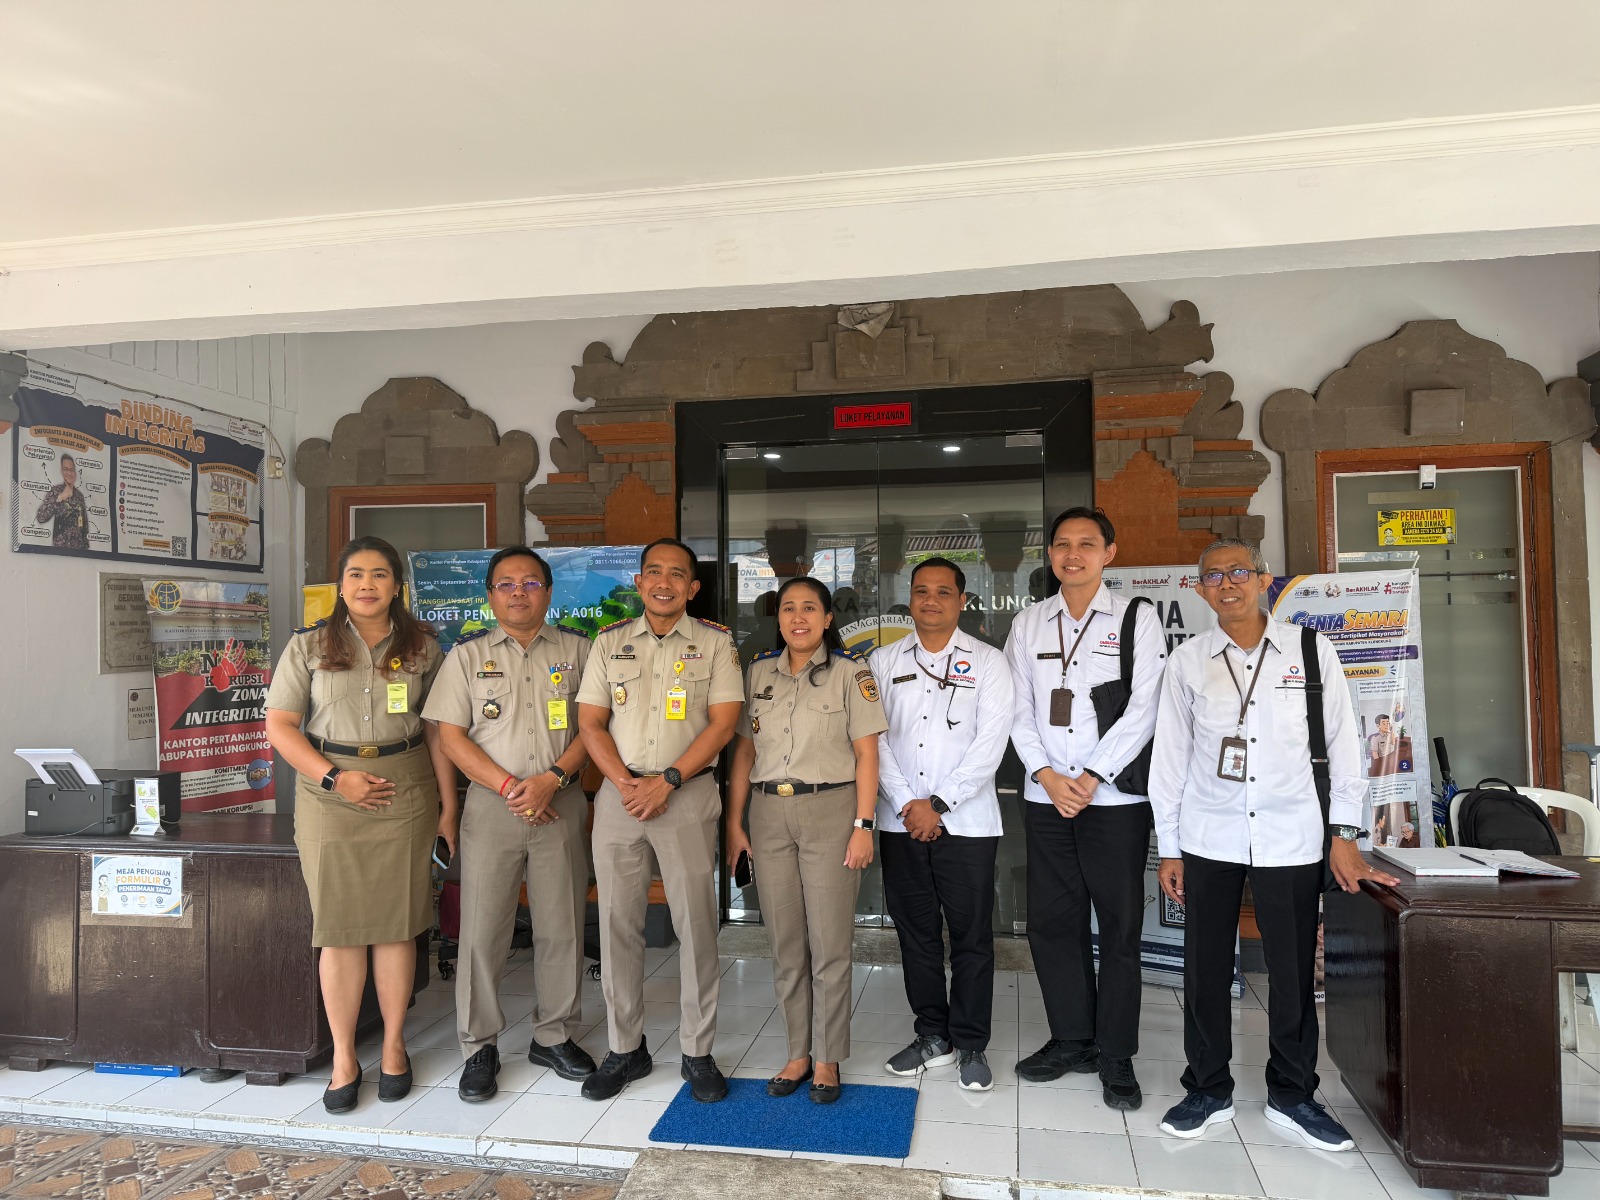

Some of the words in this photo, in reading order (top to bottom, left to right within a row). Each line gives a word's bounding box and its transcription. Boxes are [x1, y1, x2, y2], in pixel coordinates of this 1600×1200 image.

[121, 399, 193, 435] DINDING
[841, 413, 861, 422] LOKET
[864, 411, 904, 421] PELAYANAN
[105, 412, 205, 453] INTEGRITAS
[23, 482, 49, 490] Akuntabel
[1401, 510, 1443, 521] PERHATIAN
[119, 594, 144, 602] GEDUNG
[420, 610, 460, 621] LOKET
[572, 607, 603, 618] A016
[841, 623, 858, 636] IAN
[860, 617, 902, 628] AGRARIA
[1369, 630, 1404, 639] Masyarakat
[231, 688, 268, 701] ZONA
[185, 707, 268, 726] INTEGRITAS
[164, 737, 208, 750] KANTOR
[159, 748, 213, 762] ABUPATEN
[215, 741, 271, 755] KLUNGKUNG
[214, 765, 246, 774] KOMITMEN
[226, 805, 253, 813] KORUPSI
[136, 868, 171, 876] PENGISIAN
[116, 876, 161, 884] FORMULIR
